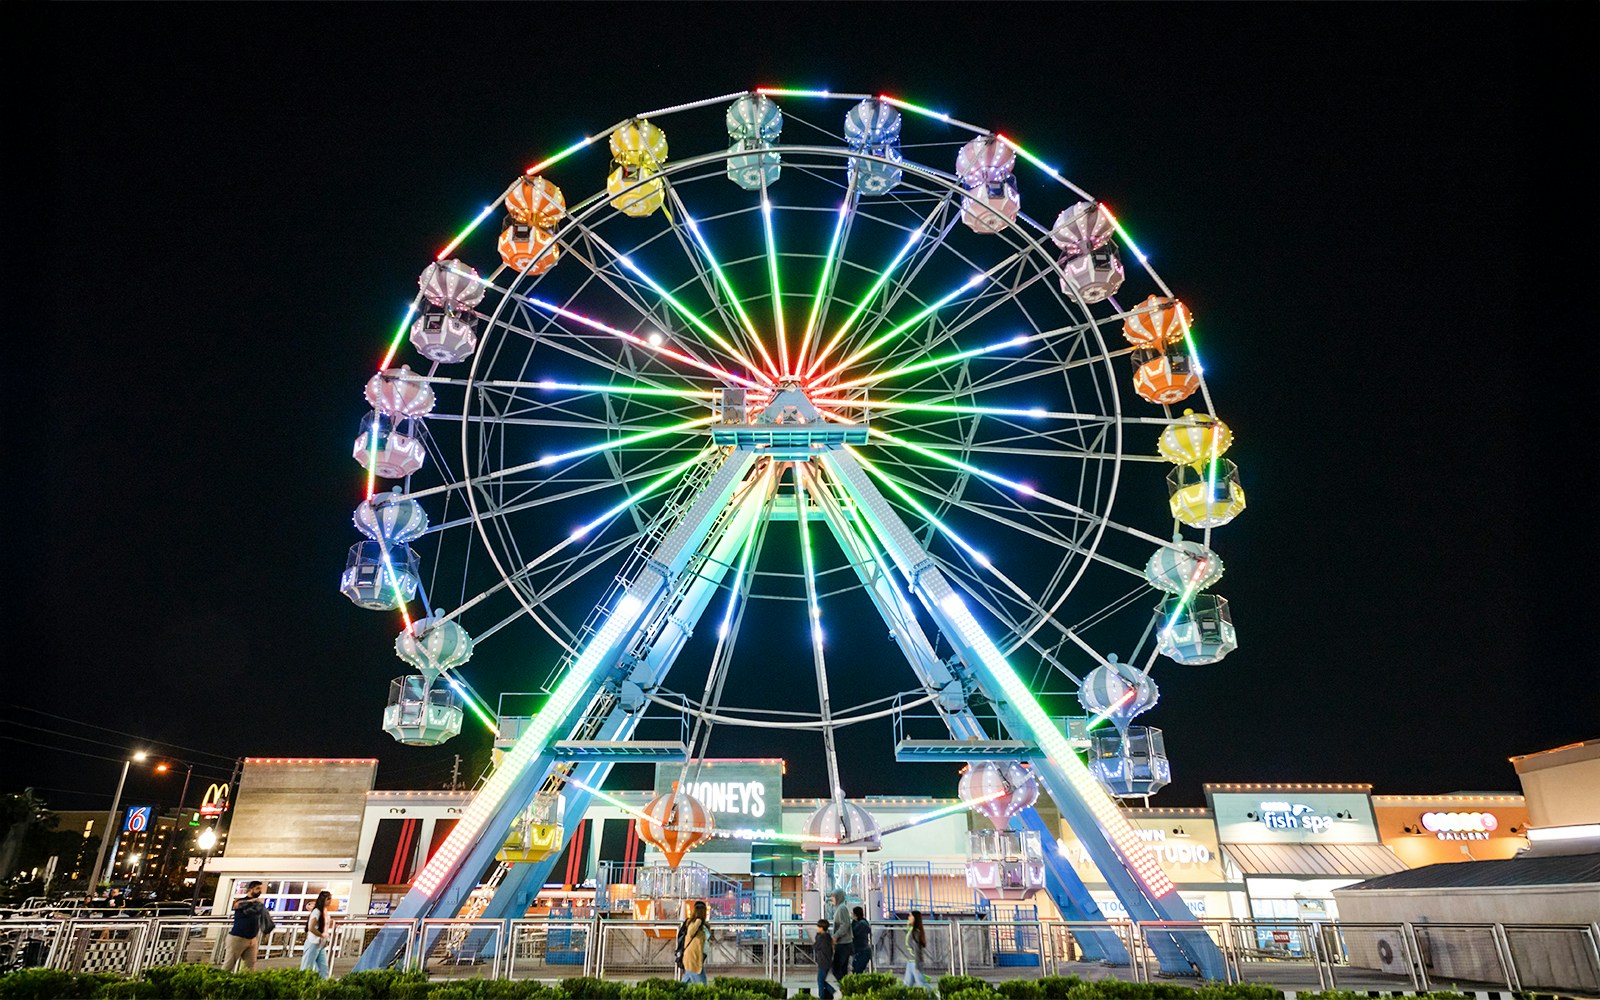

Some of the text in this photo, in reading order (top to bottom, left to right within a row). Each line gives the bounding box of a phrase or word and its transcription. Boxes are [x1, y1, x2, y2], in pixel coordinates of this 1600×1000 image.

[128, 807, 147, 832] 6
[1264, 811, 1334, 834] fish spa
[1437, 832, 1490, 841] GALLERY
